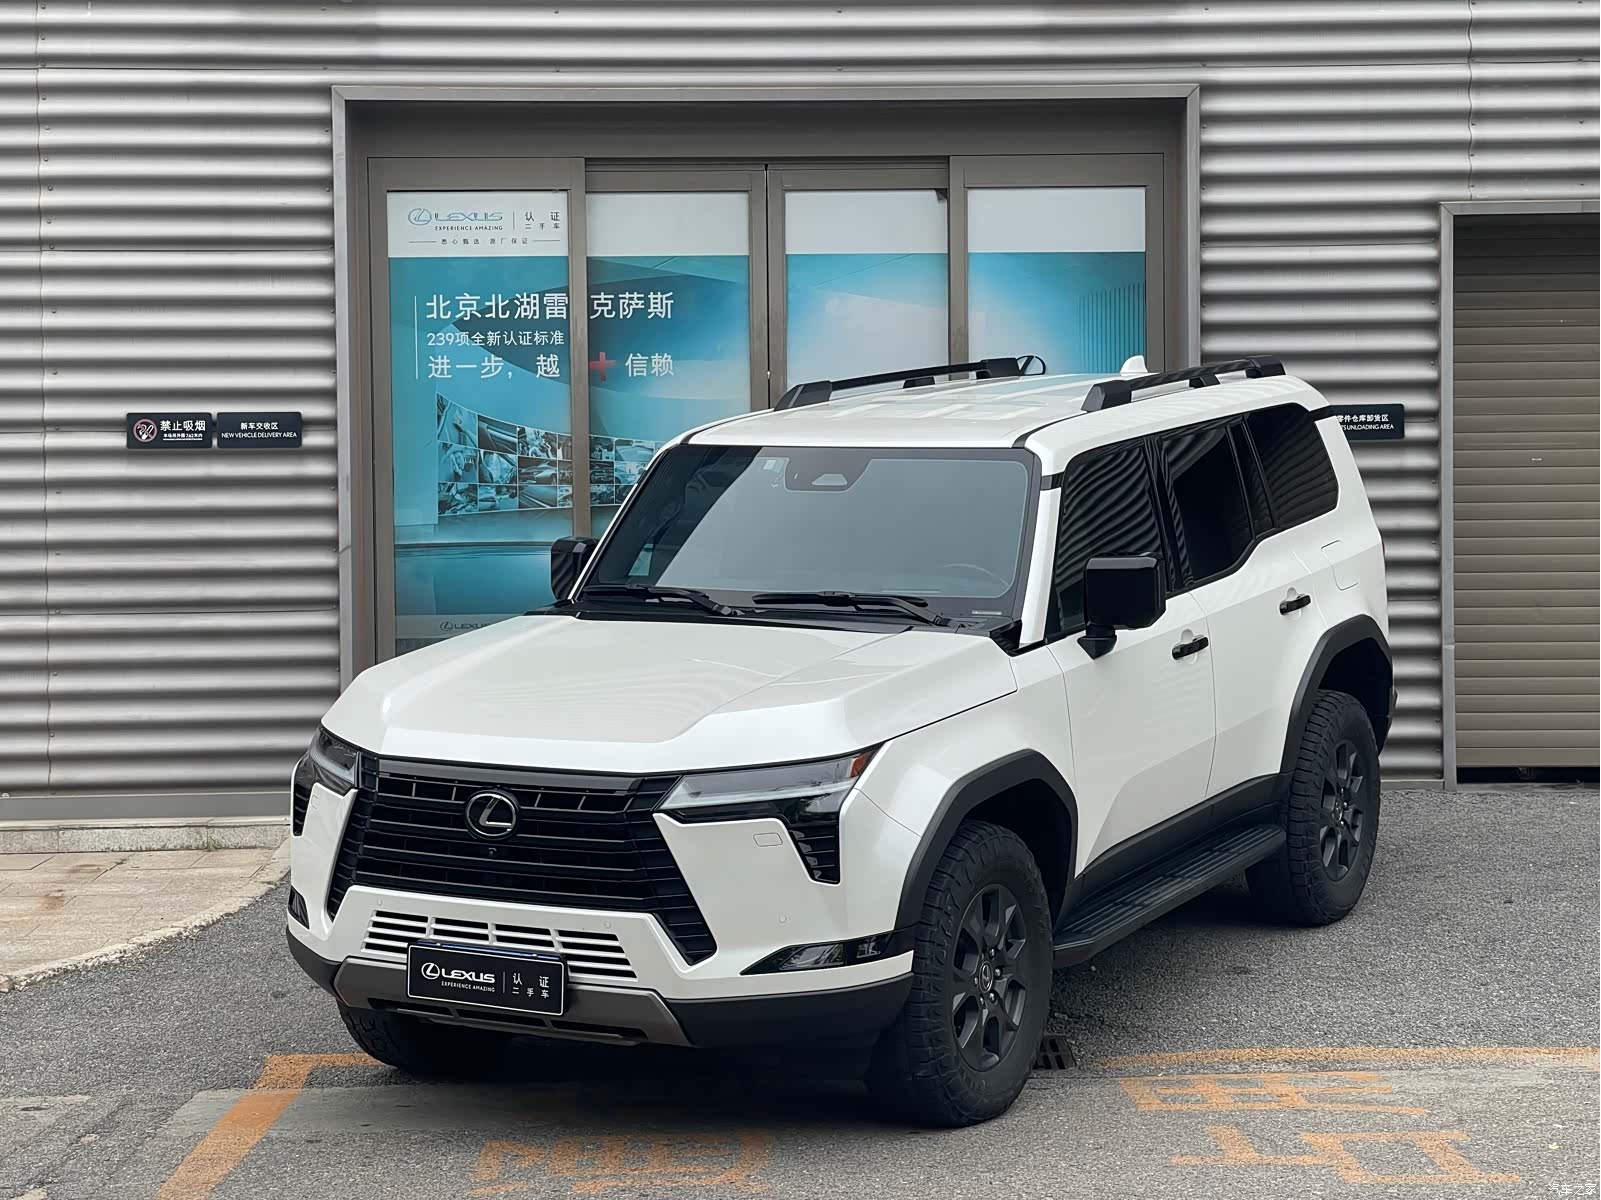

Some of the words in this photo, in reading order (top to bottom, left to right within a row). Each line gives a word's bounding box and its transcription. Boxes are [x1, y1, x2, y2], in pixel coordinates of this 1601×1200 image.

[434, 211, 503, 222] LEXUS
[525, 211, 560, 222] 认证
[525, 222, 560, 230] 二手车
[426, 330, 565, 347] 239项全新认证标准
[160, 420, 206, 432] 禁止吸烟
[240, 422, 279, 430] 新车交收区
[441, 968, 496, 984] LEXUS
[512, 972, 550, 988] 认证
[441, 980, 472, 990] EXPERIENCE
[472, 985, 496, 993] AMAZING
[512, 987, 550, 999] 二手车
